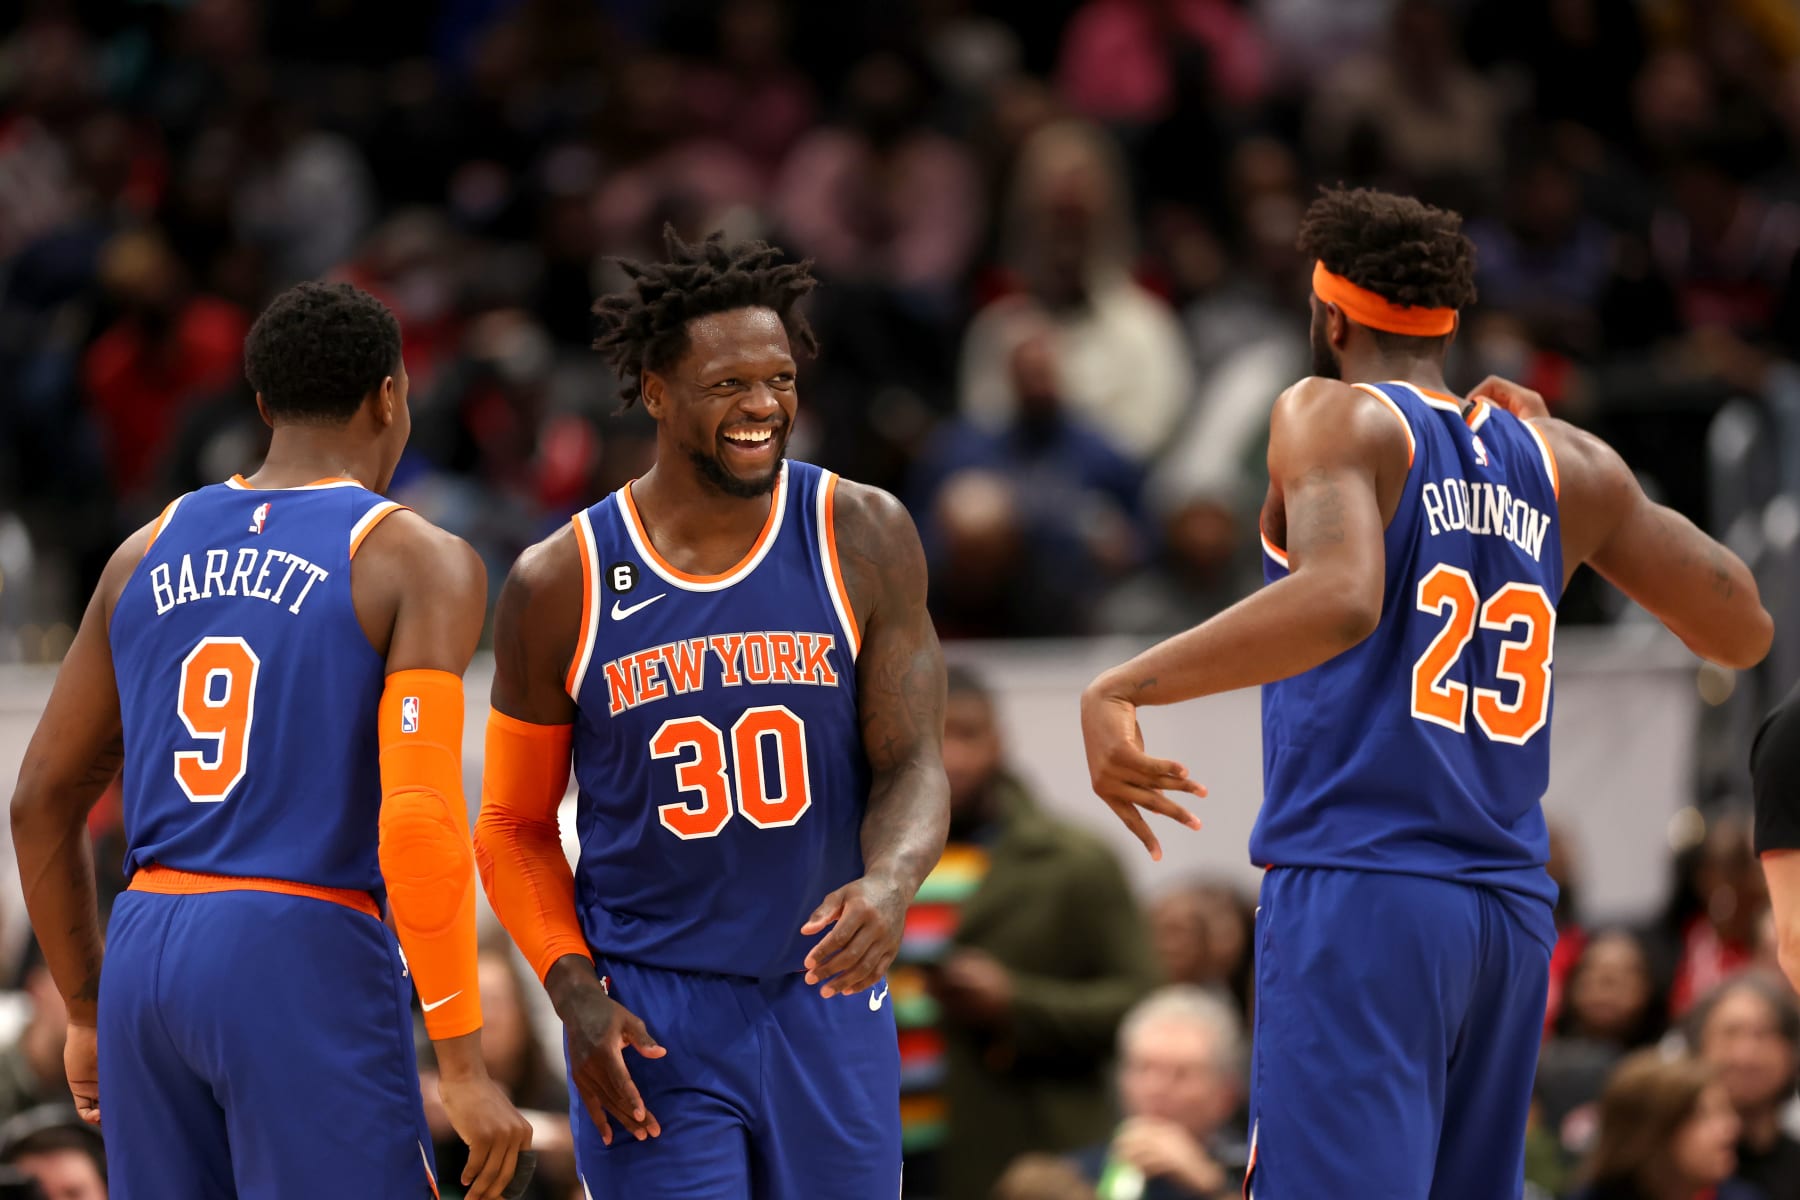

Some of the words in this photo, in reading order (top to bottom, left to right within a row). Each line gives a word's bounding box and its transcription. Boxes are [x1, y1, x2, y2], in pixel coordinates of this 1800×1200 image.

[1422, 478, 1551, 562] ROBINSON
[150, 548, 329, 615] BARRETT
[613, 565, 633, 591] 6
[602, 635, 708, 718] NEW
[709, 630, 839, 688] YORK
[1410, 562, 1557, 746] 23
[174, 636, 261, 803] 9
[649, 704, 812, 840] 30
